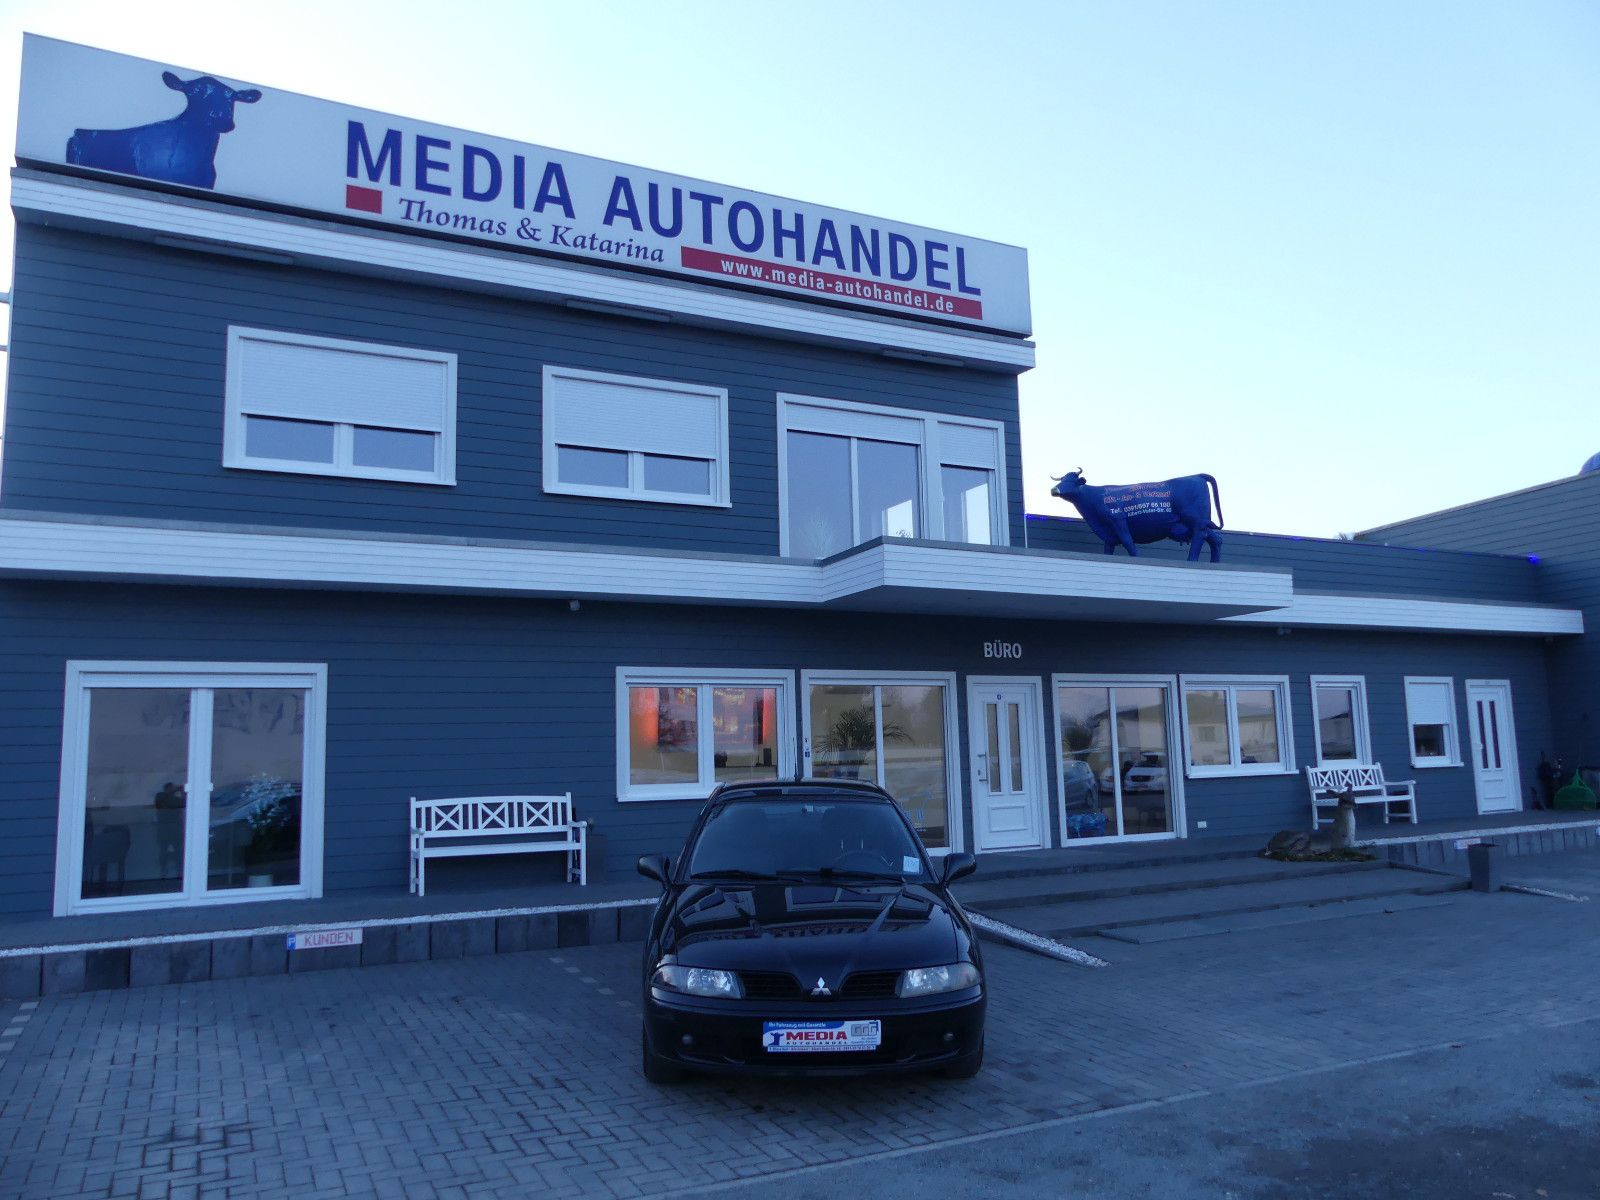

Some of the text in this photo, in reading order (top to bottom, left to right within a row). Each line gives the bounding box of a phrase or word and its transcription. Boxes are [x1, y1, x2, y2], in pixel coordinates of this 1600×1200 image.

[346, 120, 981, 296] MEDIA AUTOHANDEL
[399, 198, 665, 263] Thomas & Katarina
[720, 258, 954, 313] www.media-autohandel.de
[983, 640, 1022, 659] BÜRO
[304, 931, 353, 946] KUNDEN
[786, 1031, 847, 1041] MEDIA
